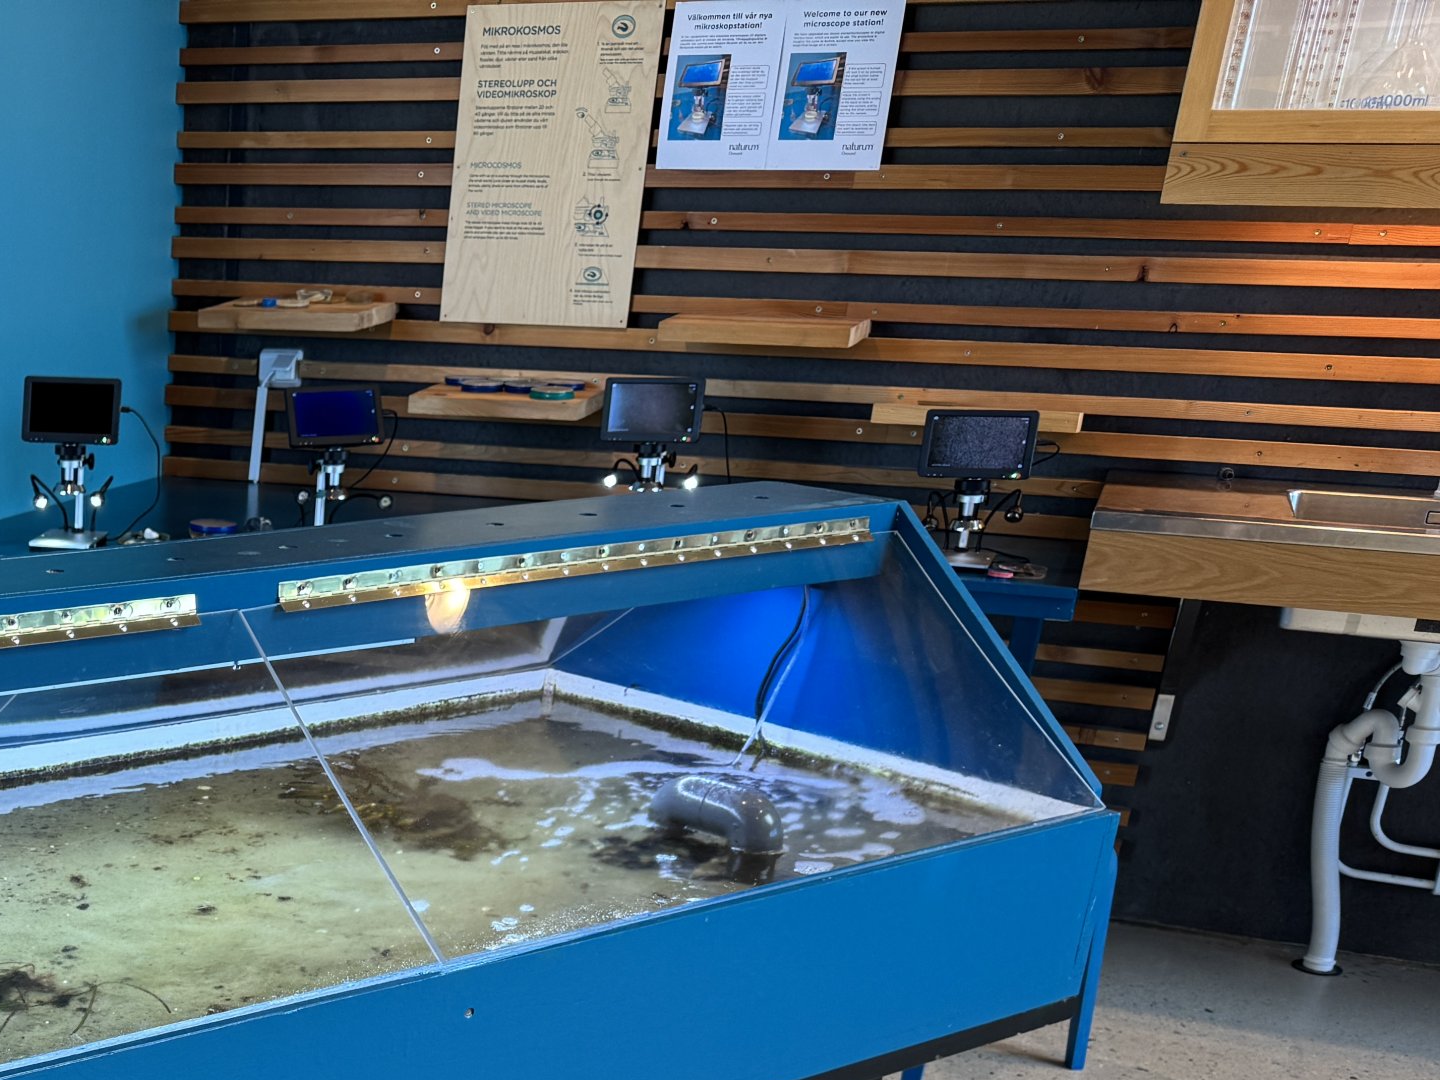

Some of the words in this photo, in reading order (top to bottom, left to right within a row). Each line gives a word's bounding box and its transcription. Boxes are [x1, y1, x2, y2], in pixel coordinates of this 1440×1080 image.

[687, 13, 730, 21] Välkommen
[732, 12, 743, 20] till
[745, 11, 757, 19] vår
[758, 12, 773, 20] nya
[803, 10, 841, 18] Welcome
[694, 22, 763, 31] mikroskopstation!
[803, 20, 850, 28] microscope
[852, 18, 884, 27] station!
[482, 25, 561, 37] MIKROKOSMOS
[477, 79, 535, 88] STEREOLUPP
[536, 79, 557, 88] OCH
[476, 89, 557, 99] VIDEOMIKROSKOP
[728, 142, 760, 151] naturum
[841, 141, 874, 151] naturum
[470, 161, 522, 169] MICROCOSMOS
